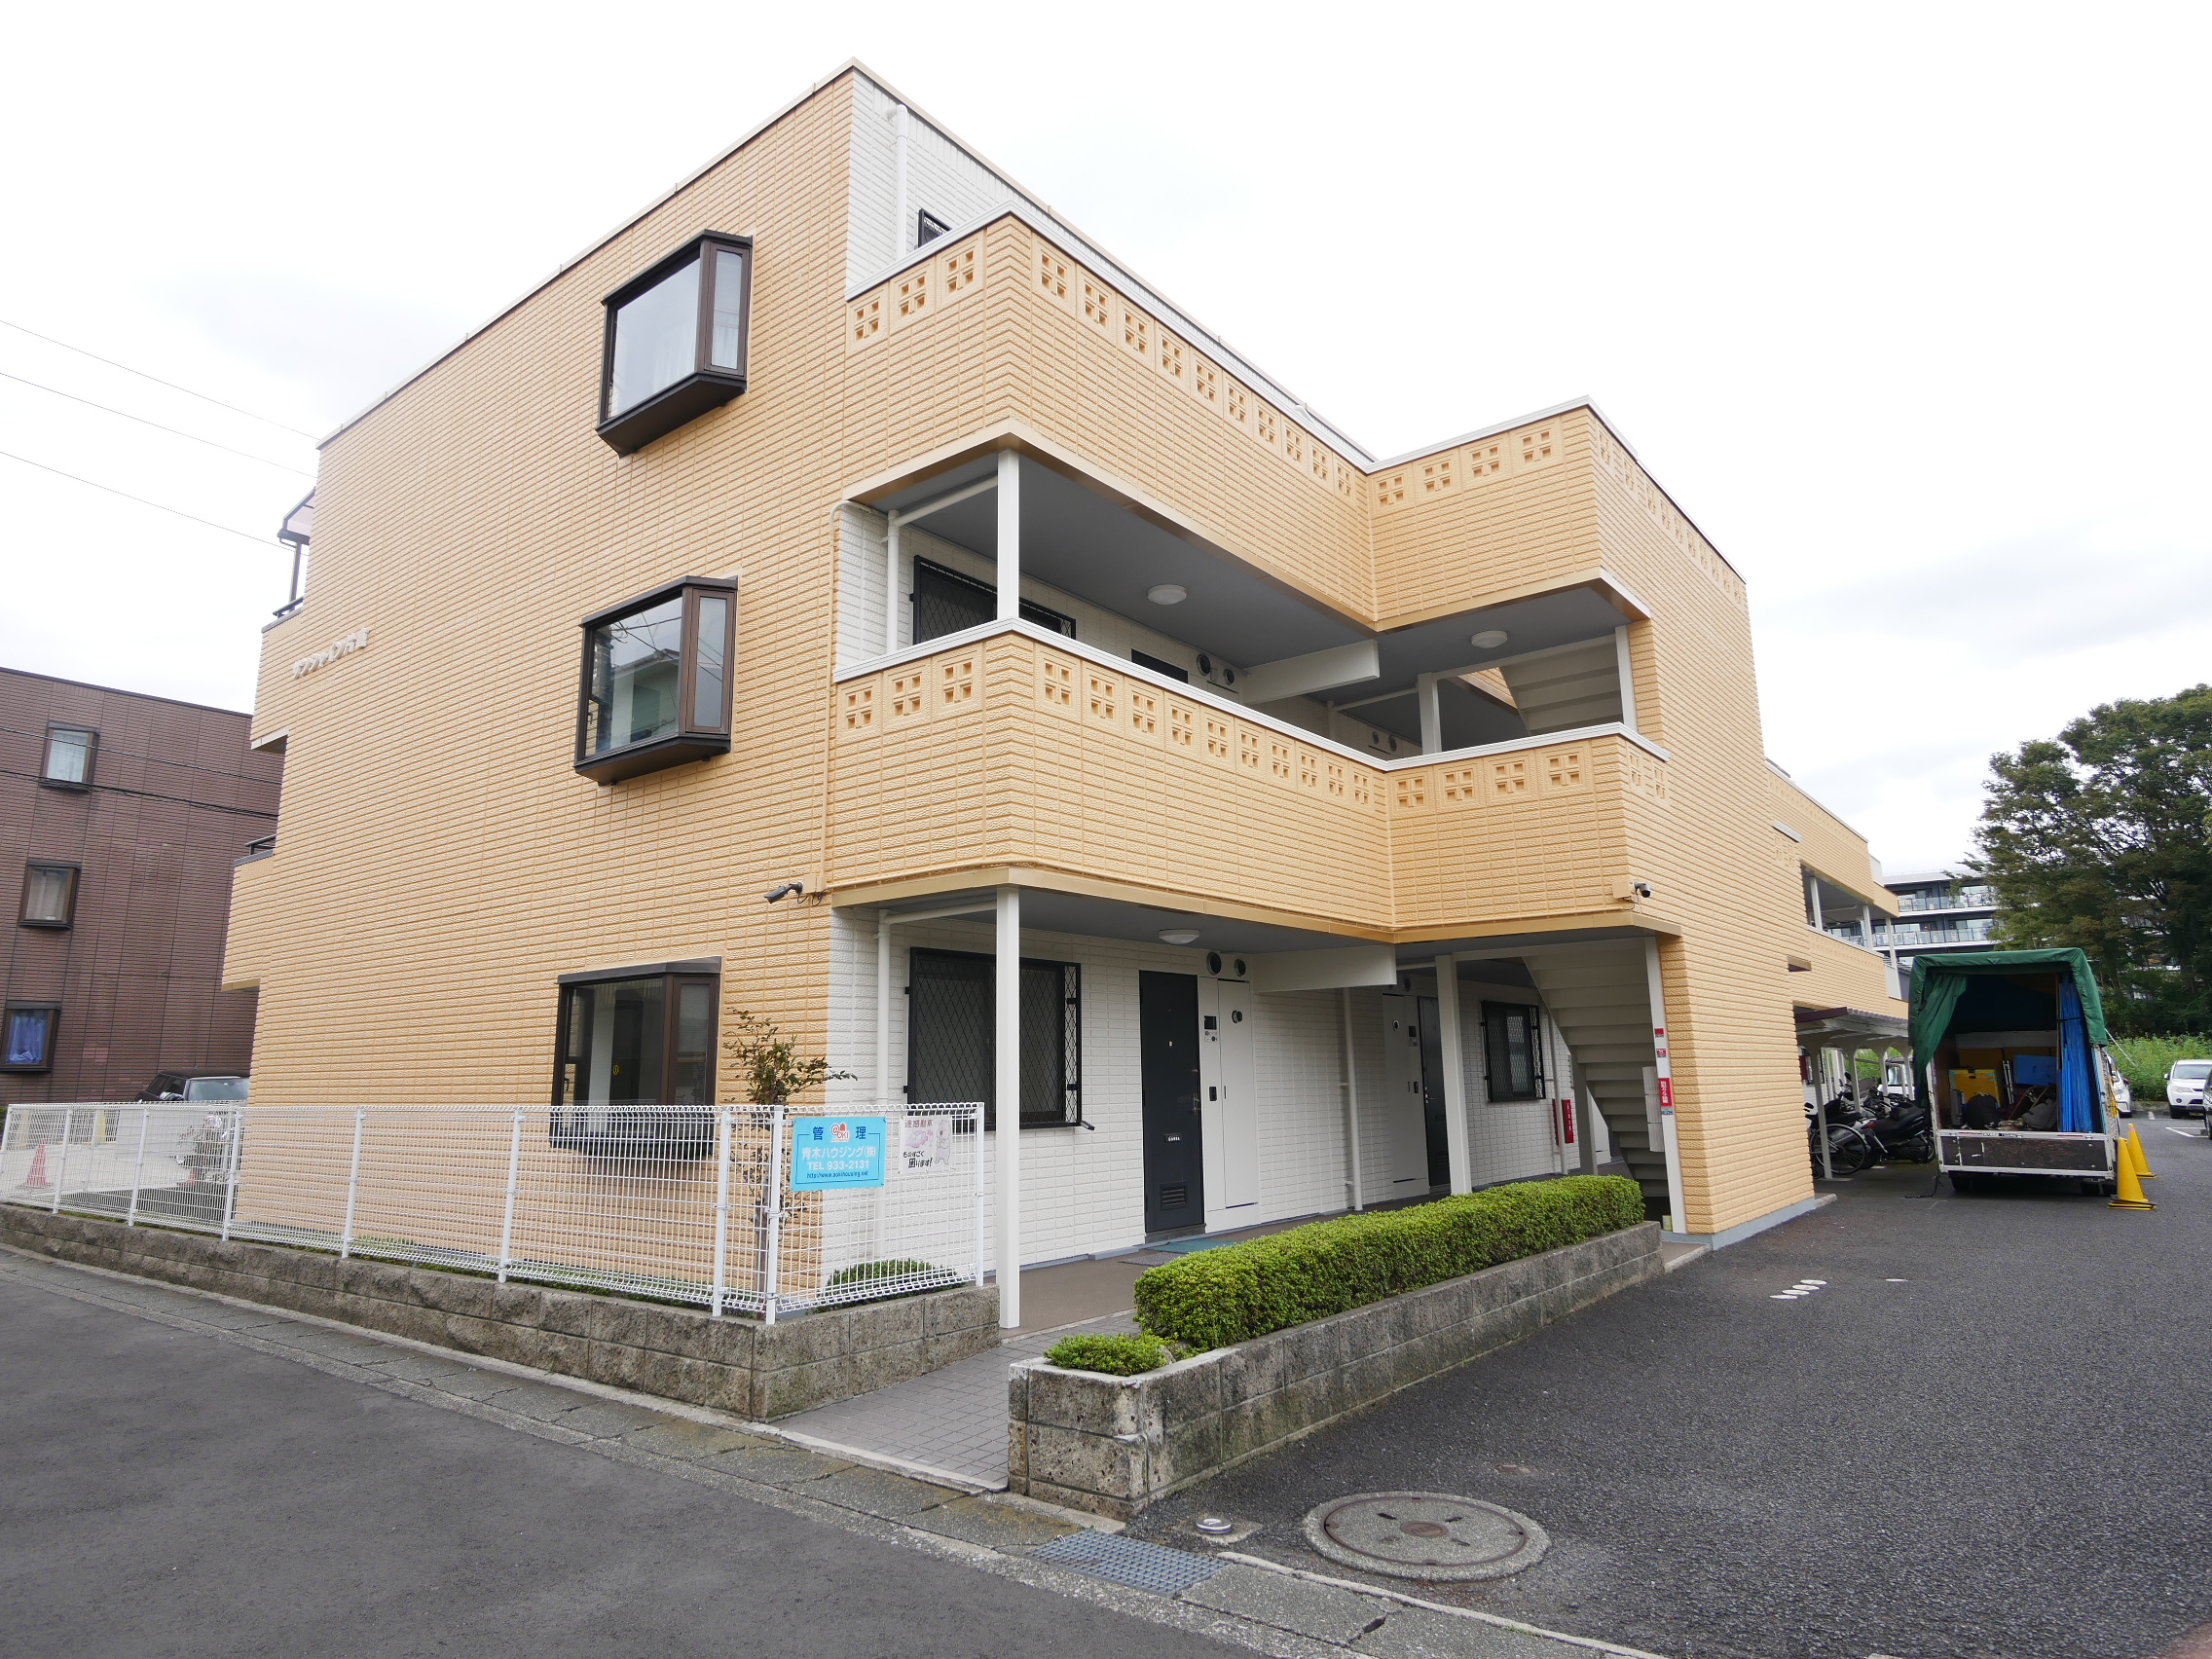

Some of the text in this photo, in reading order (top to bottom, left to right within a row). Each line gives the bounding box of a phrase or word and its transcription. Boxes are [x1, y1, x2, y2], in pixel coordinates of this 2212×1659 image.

[812, 1125, 825, 1140] 管
[855, 1125, 866, 1140] 理
[807, 1160, 869, 1170] TEL 933-2131
